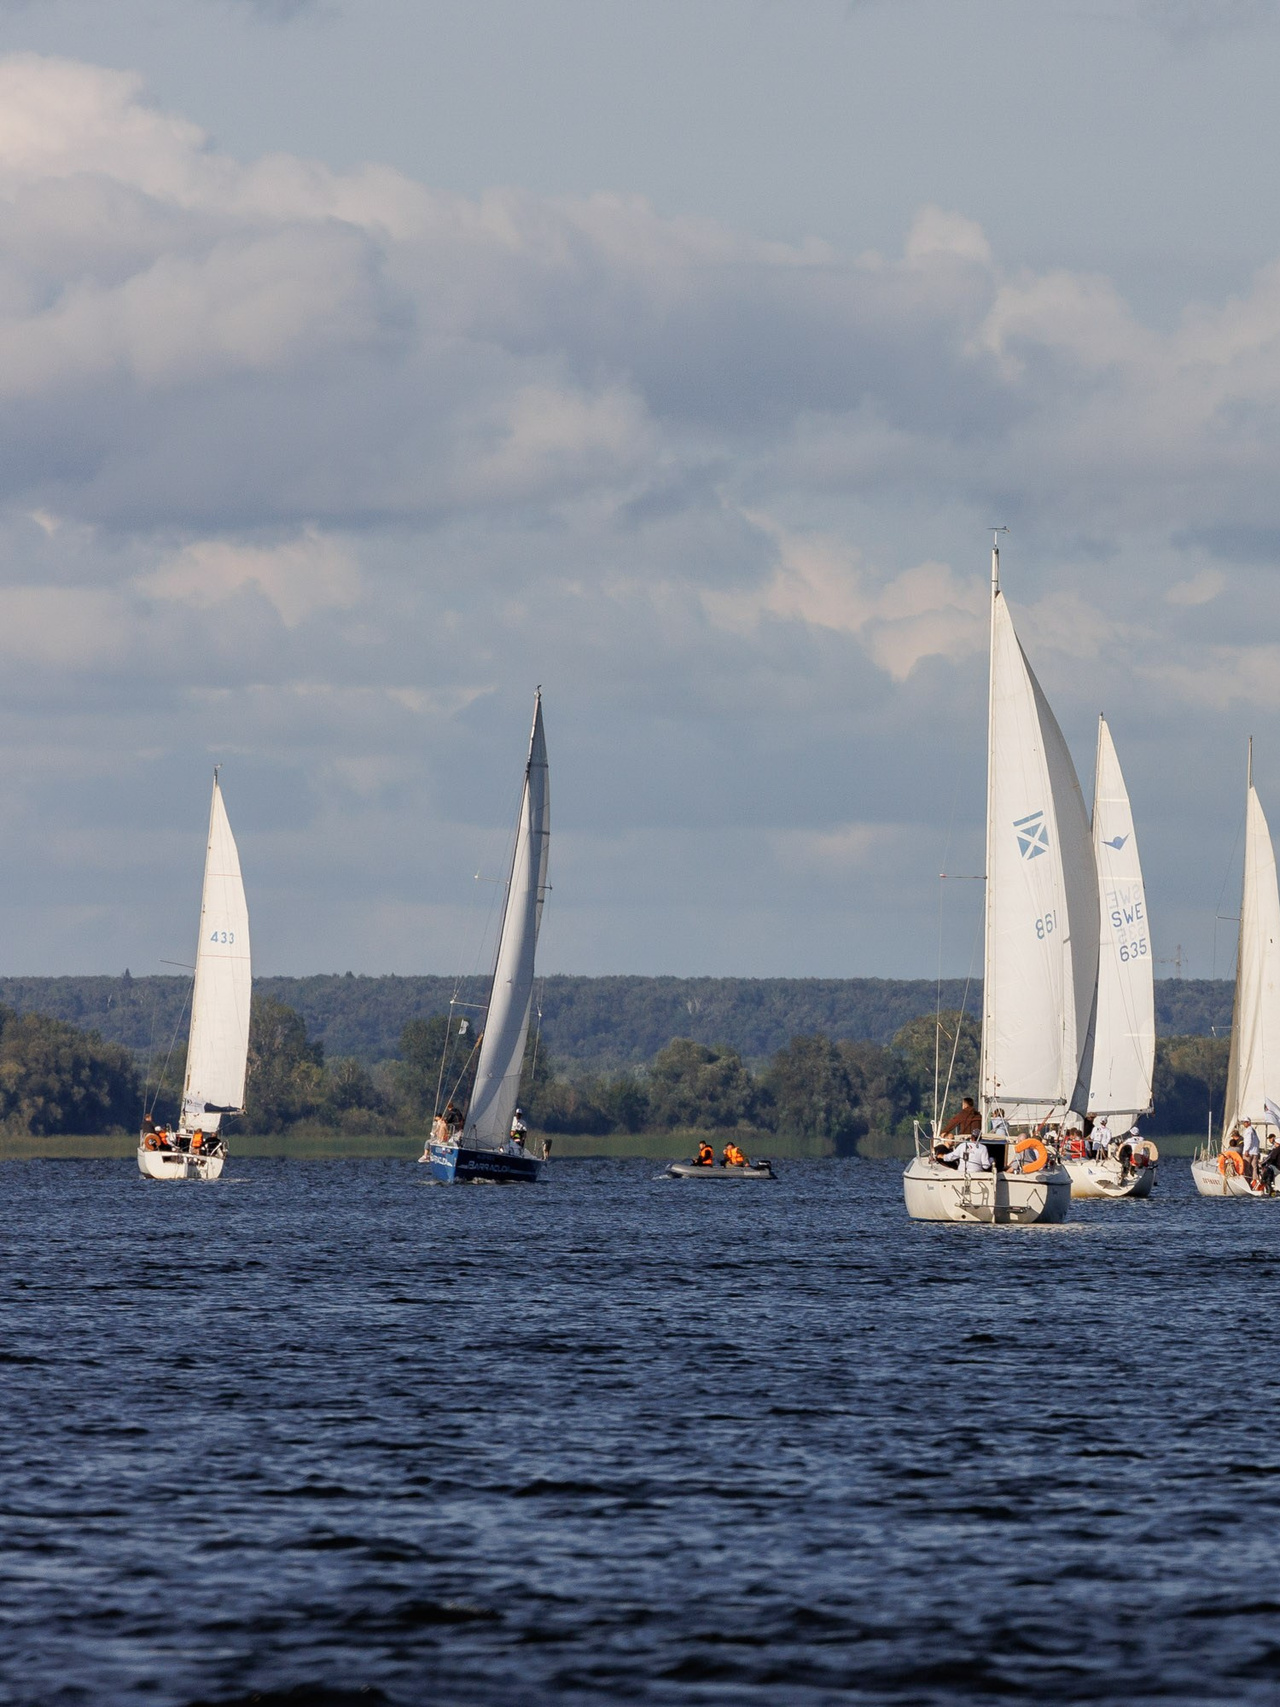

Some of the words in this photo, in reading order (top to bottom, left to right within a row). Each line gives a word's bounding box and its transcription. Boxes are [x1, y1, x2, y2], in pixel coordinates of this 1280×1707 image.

[1111, 902, 1144, 928] SWE
[210, 931, 235, 945] 433
[1119, 938, 1147, 962] 635
